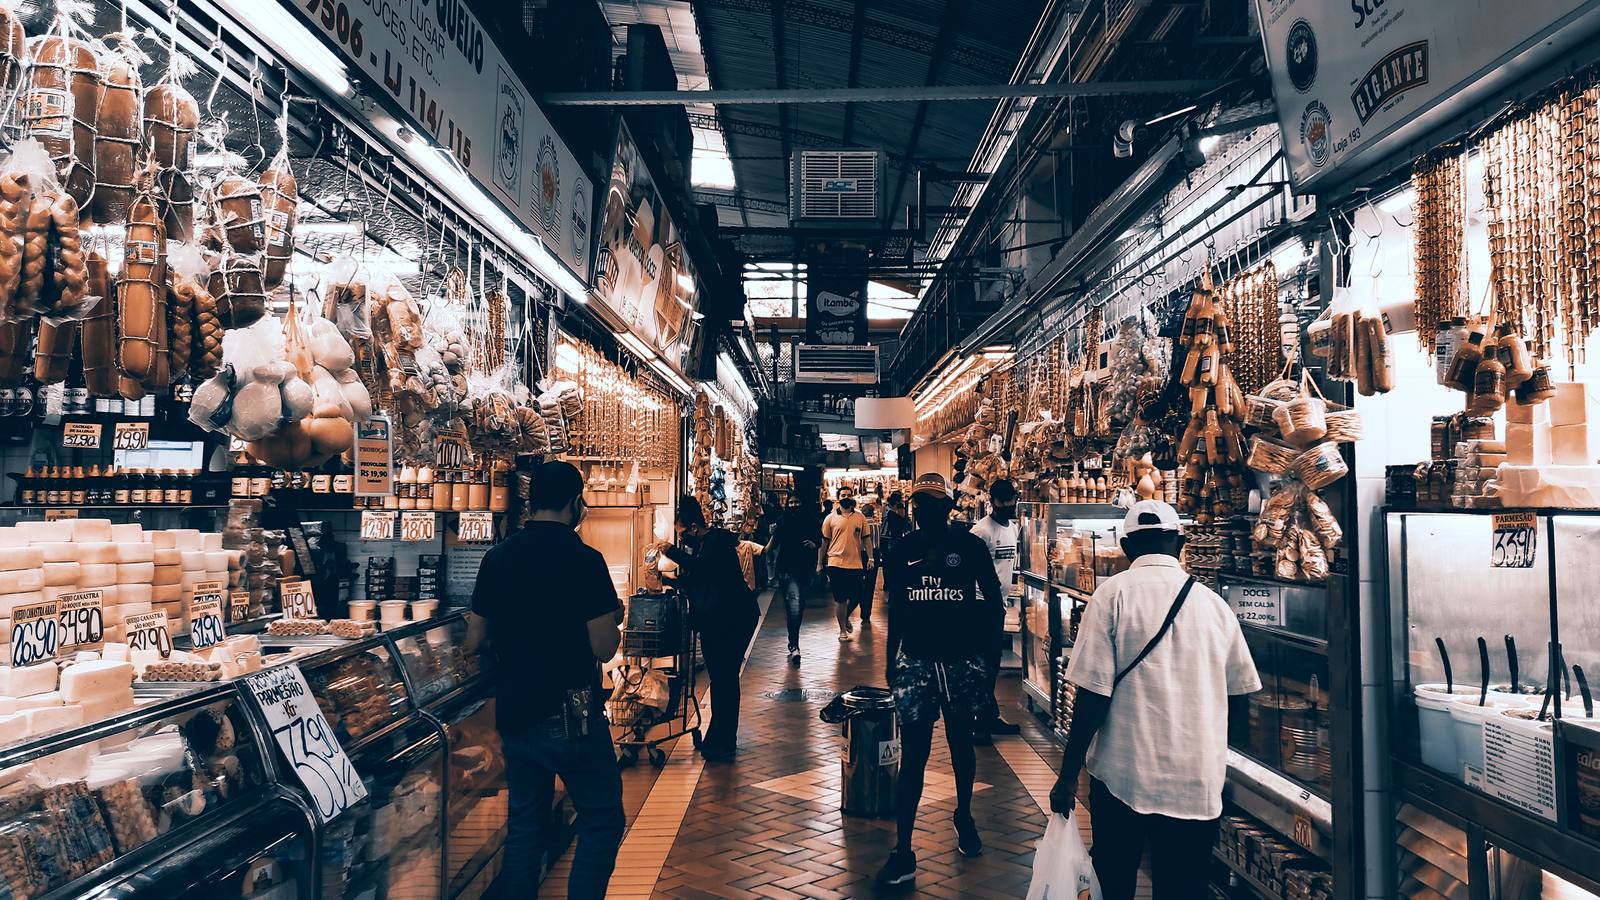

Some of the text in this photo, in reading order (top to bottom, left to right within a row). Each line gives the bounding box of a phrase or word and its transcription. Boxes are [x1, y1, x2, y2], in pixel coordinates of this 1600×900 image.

[410, 0, 446, 60] LUGAR
[436, 0, 484, 75] QUEIJO
[1356, 50, 1424, 118] GIGANTE
[384, 49, 402, 98] LJ
[449, 119, 471, 169] 115
[1333, 127, 1361, 153] Loja 193
[360, 469, 388, 478] R$ 19,90
[1496, 513, 1532, 523] PARMESÃO
[922, 576, 941, 588] Fly
[74, 592, 100, 601] CANASTRA
[907, 587, 963, 601] Emirates
[1243, 589, 1271, 597] DOCES
[68, 601, 81, 609] ROQUE
[14, 611, 27, 623] QUEIJO
[26, 606, 44, 619] CANASTRA
[126, 612, 165, 626] QUEIJO CANASTRA
[1236, 612, 1245, 620] R$
[12, 618, 57, 667] 26,90
[256, 682, 303, 706] PARMESÃO
